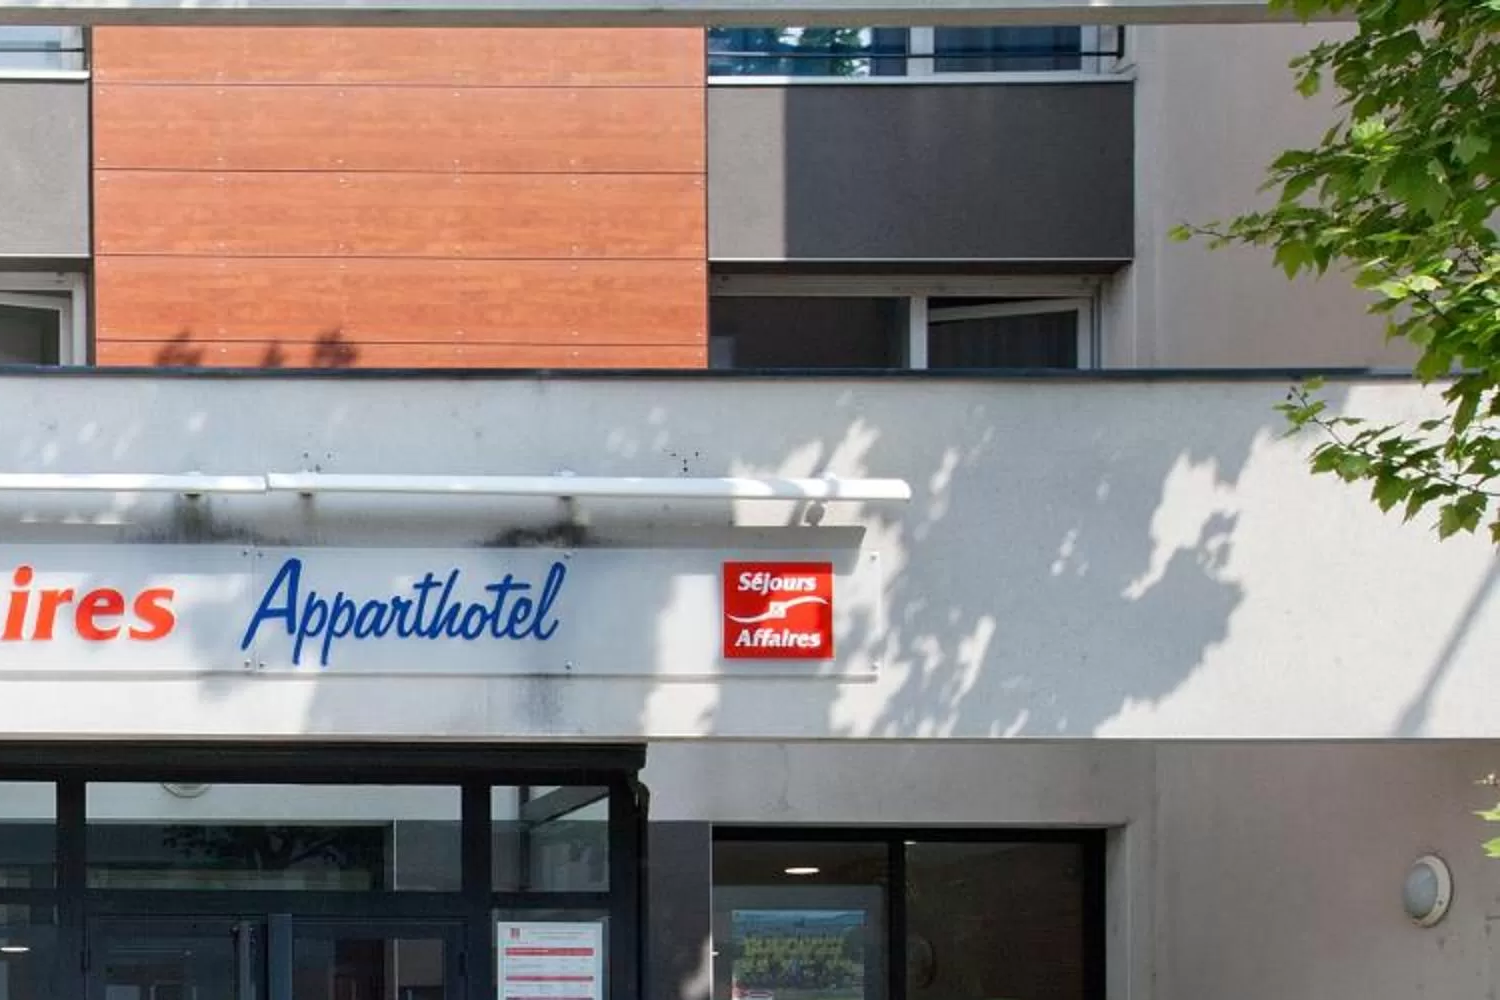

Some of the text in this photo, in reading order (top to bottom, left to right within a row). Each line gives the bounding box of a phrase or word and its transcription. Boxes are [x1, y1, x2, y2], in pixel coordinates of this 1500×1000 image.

[737, 571, 818, 596] Séjours
[241, 557, 567, 667] Apparthotel
[734, 627, 821, 648] Affaires
